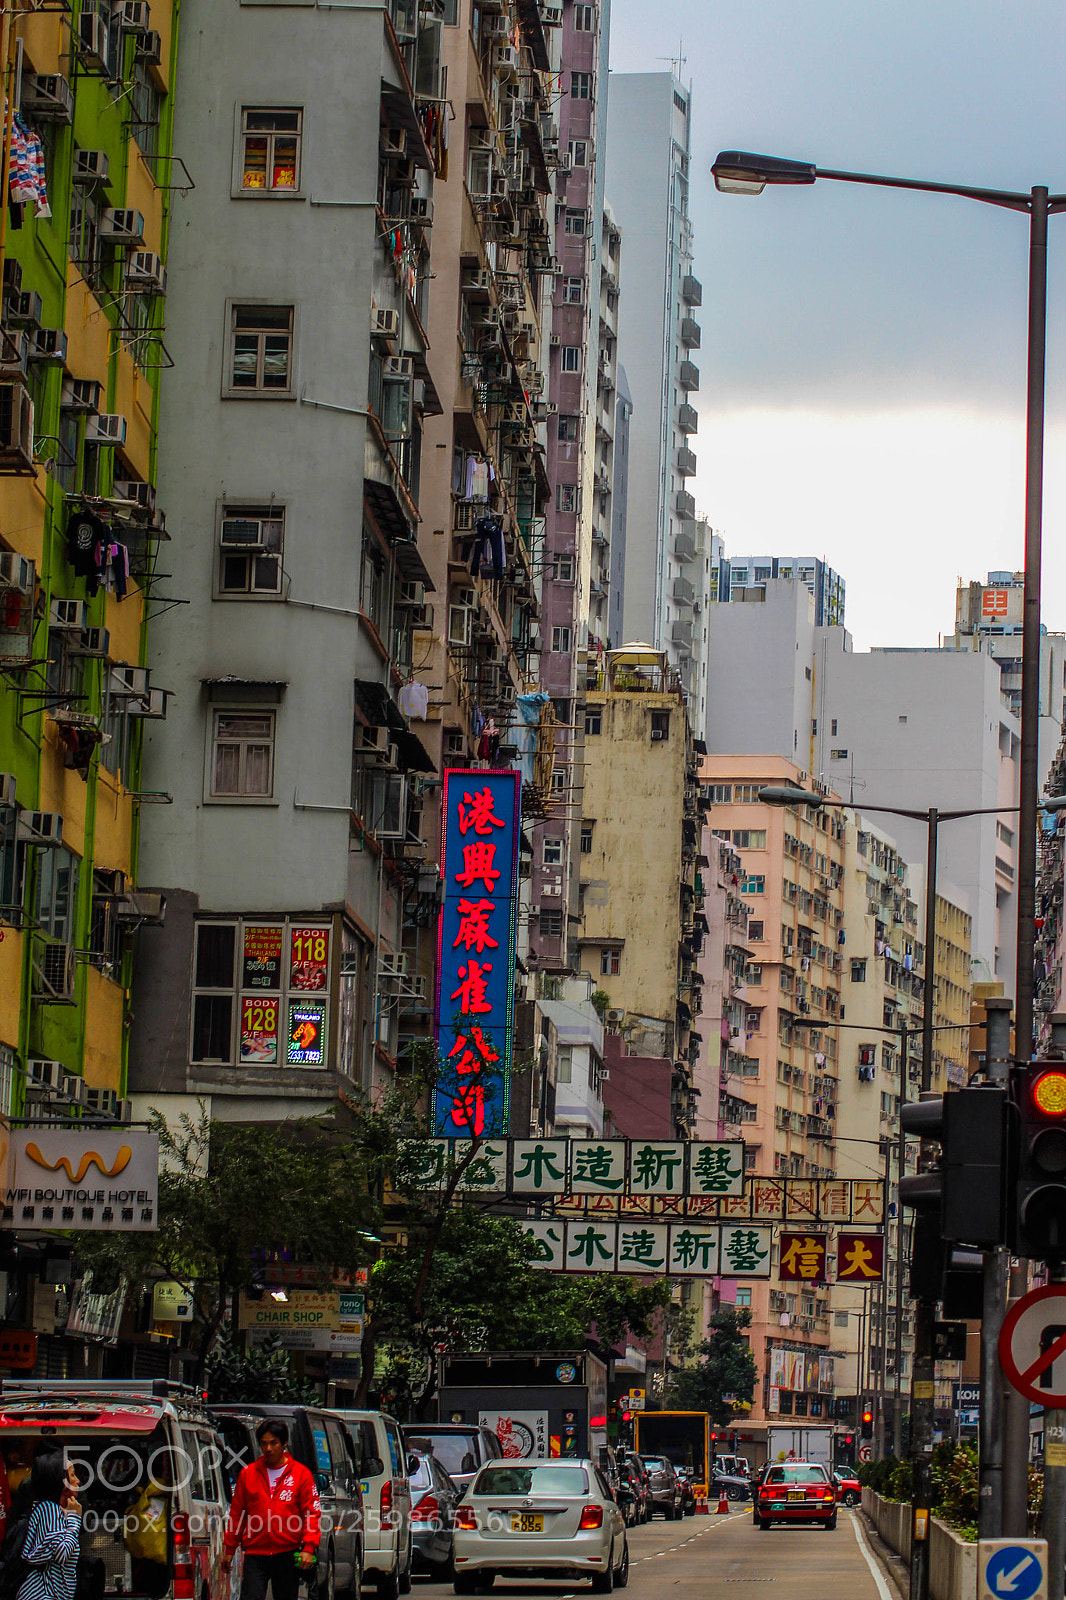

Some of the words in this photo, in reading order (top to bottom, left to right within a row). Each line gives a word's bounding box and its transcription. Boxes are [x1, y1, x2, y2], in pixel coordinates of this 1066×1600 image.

[295, 929, 327, 937] FOOT
[248, 949, 278, 957] THAILAND
[293, 937, 326, 962] 118
[293, 960, 309, 968] 2/F
[245, 999, 278, 1007] BODY
[243, 1007, 276, 1031] 128
[242, 1030, 260, 1039] 2/F
[34, 1188, 105, 1202] BOUTIQUE
[109, 1190, 153, 1202] HOTEL
[256, 1311, 290, 1323] CHAIR
[293, 1311, 323, 1323] SHOP
